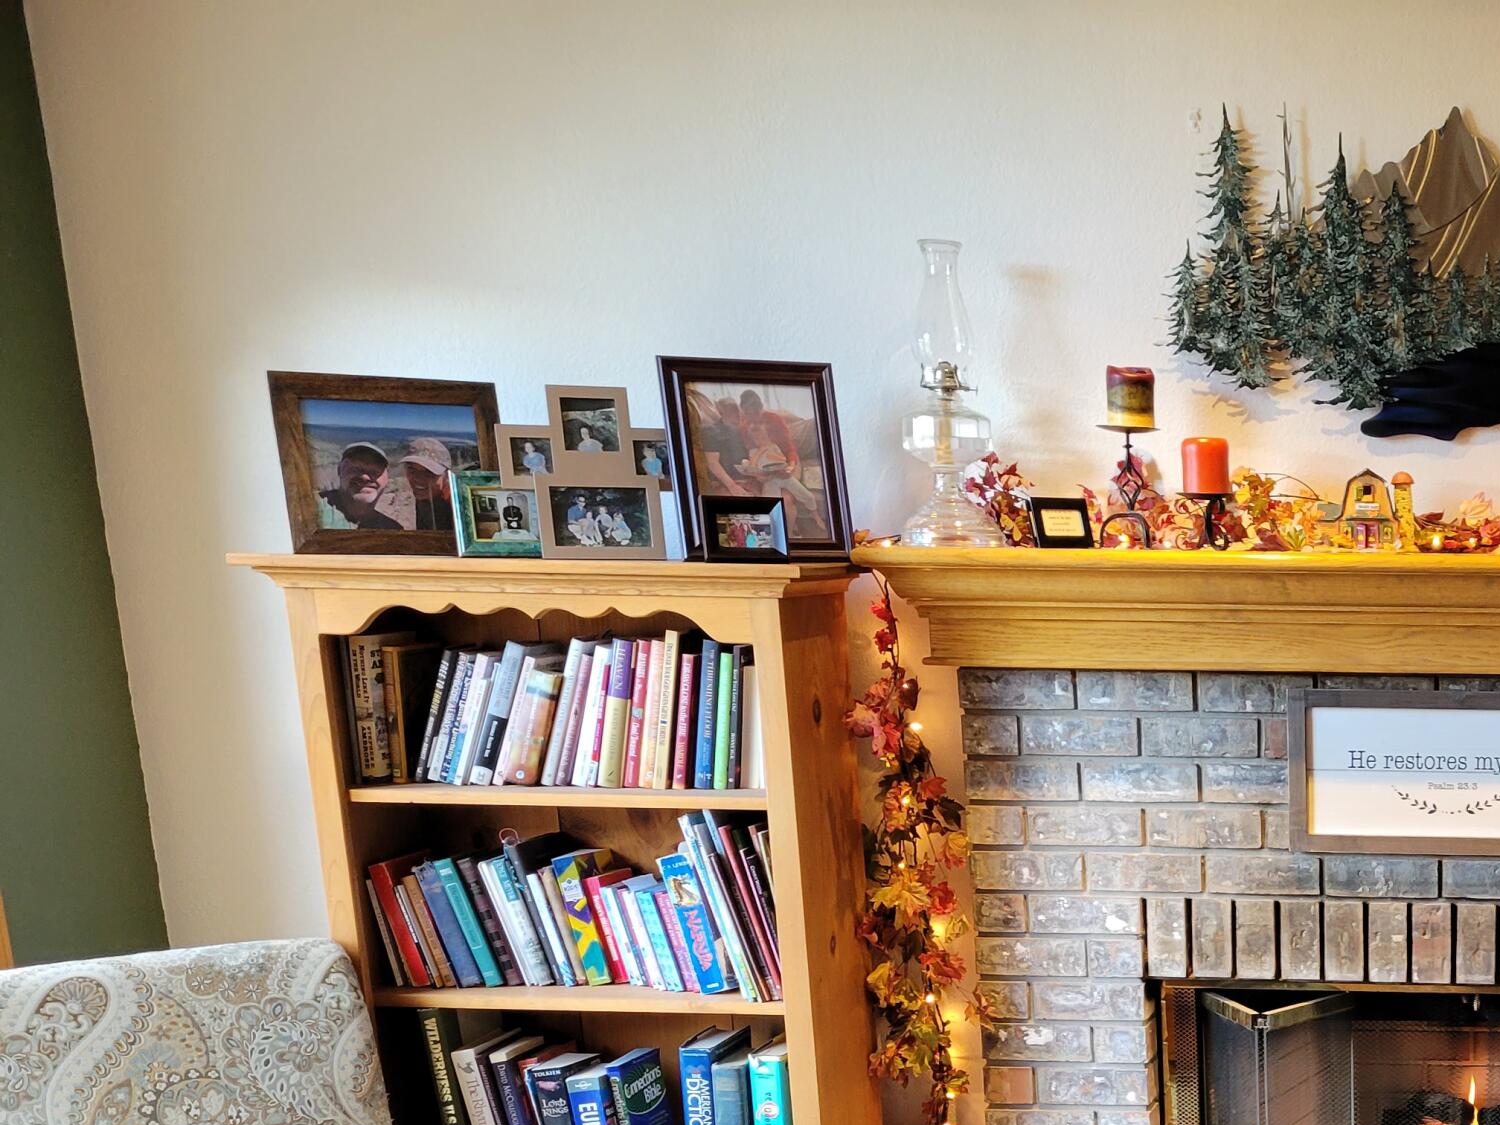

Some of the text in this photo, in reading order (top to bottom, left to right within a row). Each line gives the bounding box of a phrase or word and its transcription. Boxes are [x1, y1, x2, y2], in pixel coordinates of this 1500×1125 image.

[437, 659, 449, 678] FREE
[613, 648, 625, 690] HEAVEN
[428, 687, 443, 715] THRIVE
[359, 725, 370, 769] AMBROSE
[1347, 750, 1377, 770] He
[1383, 752, 1468, 771] restores
[1427, 781, 1456, 791] Psalm
[683, 907, 716, 972] NARNIA
[422, 1016, 453, 1103] WILDERNESS
[496, 1063, 509, 1084] DAVID
[533, 1069, 562, 1078] TOLKIEN
[623, 1065, 662, 1099] Connections
[466, 1077, 481, 1098] The
[643, 1082, 662, 1103] Bible
[542, 1098, 567, 1108] LORD
